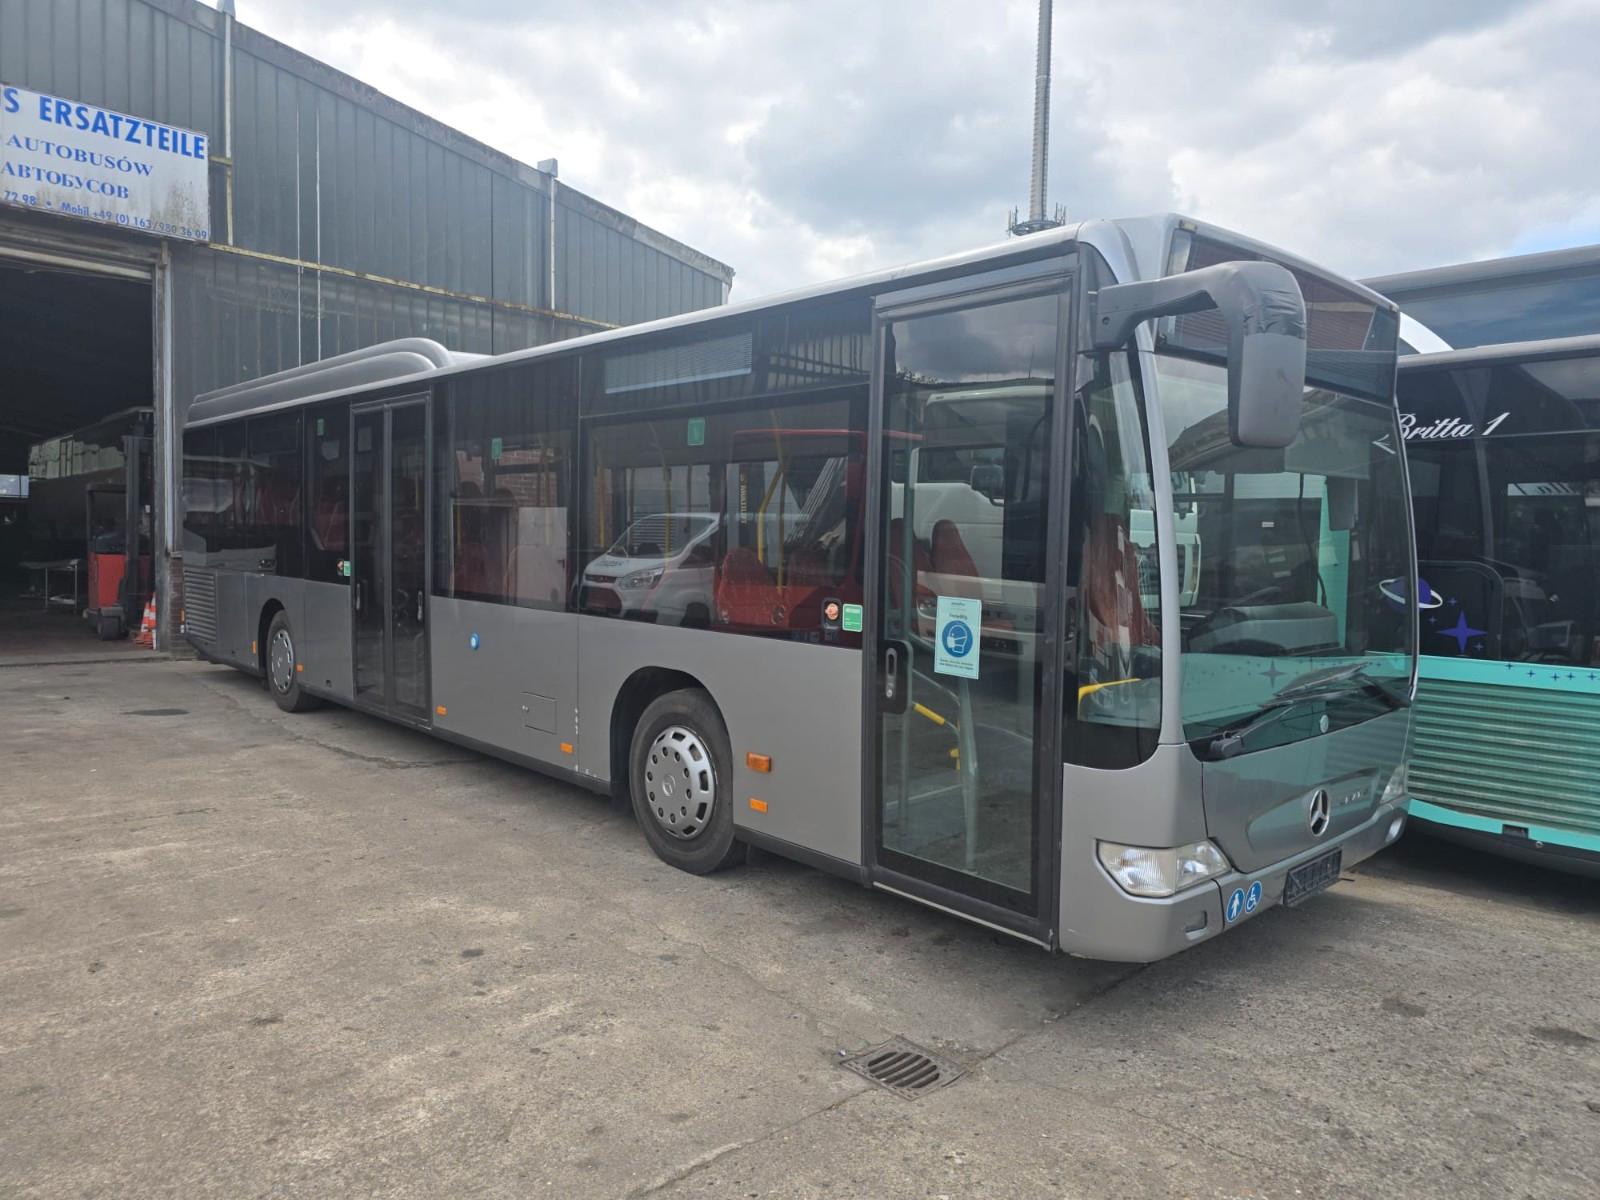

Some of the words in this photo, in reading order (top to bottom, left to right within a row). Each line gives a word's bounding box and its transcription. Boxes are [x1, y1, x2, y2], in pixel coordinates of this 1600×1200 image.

[39, 95, 205, 160] ERSATZTEILE
[6, 134, 153, 177] AUTOBUSÓW
[0, 161, 129, 199] АВТОБУСОВ
[22, 194, 37, 206] 98
[61, 201, 90, 216] Mobil
[93, 209, 112, 222] +49
[116, 212, 130, 226] (0)
[1399, 413, 1475, 440] Britta
[1482, 412, 1511, 436] 1
